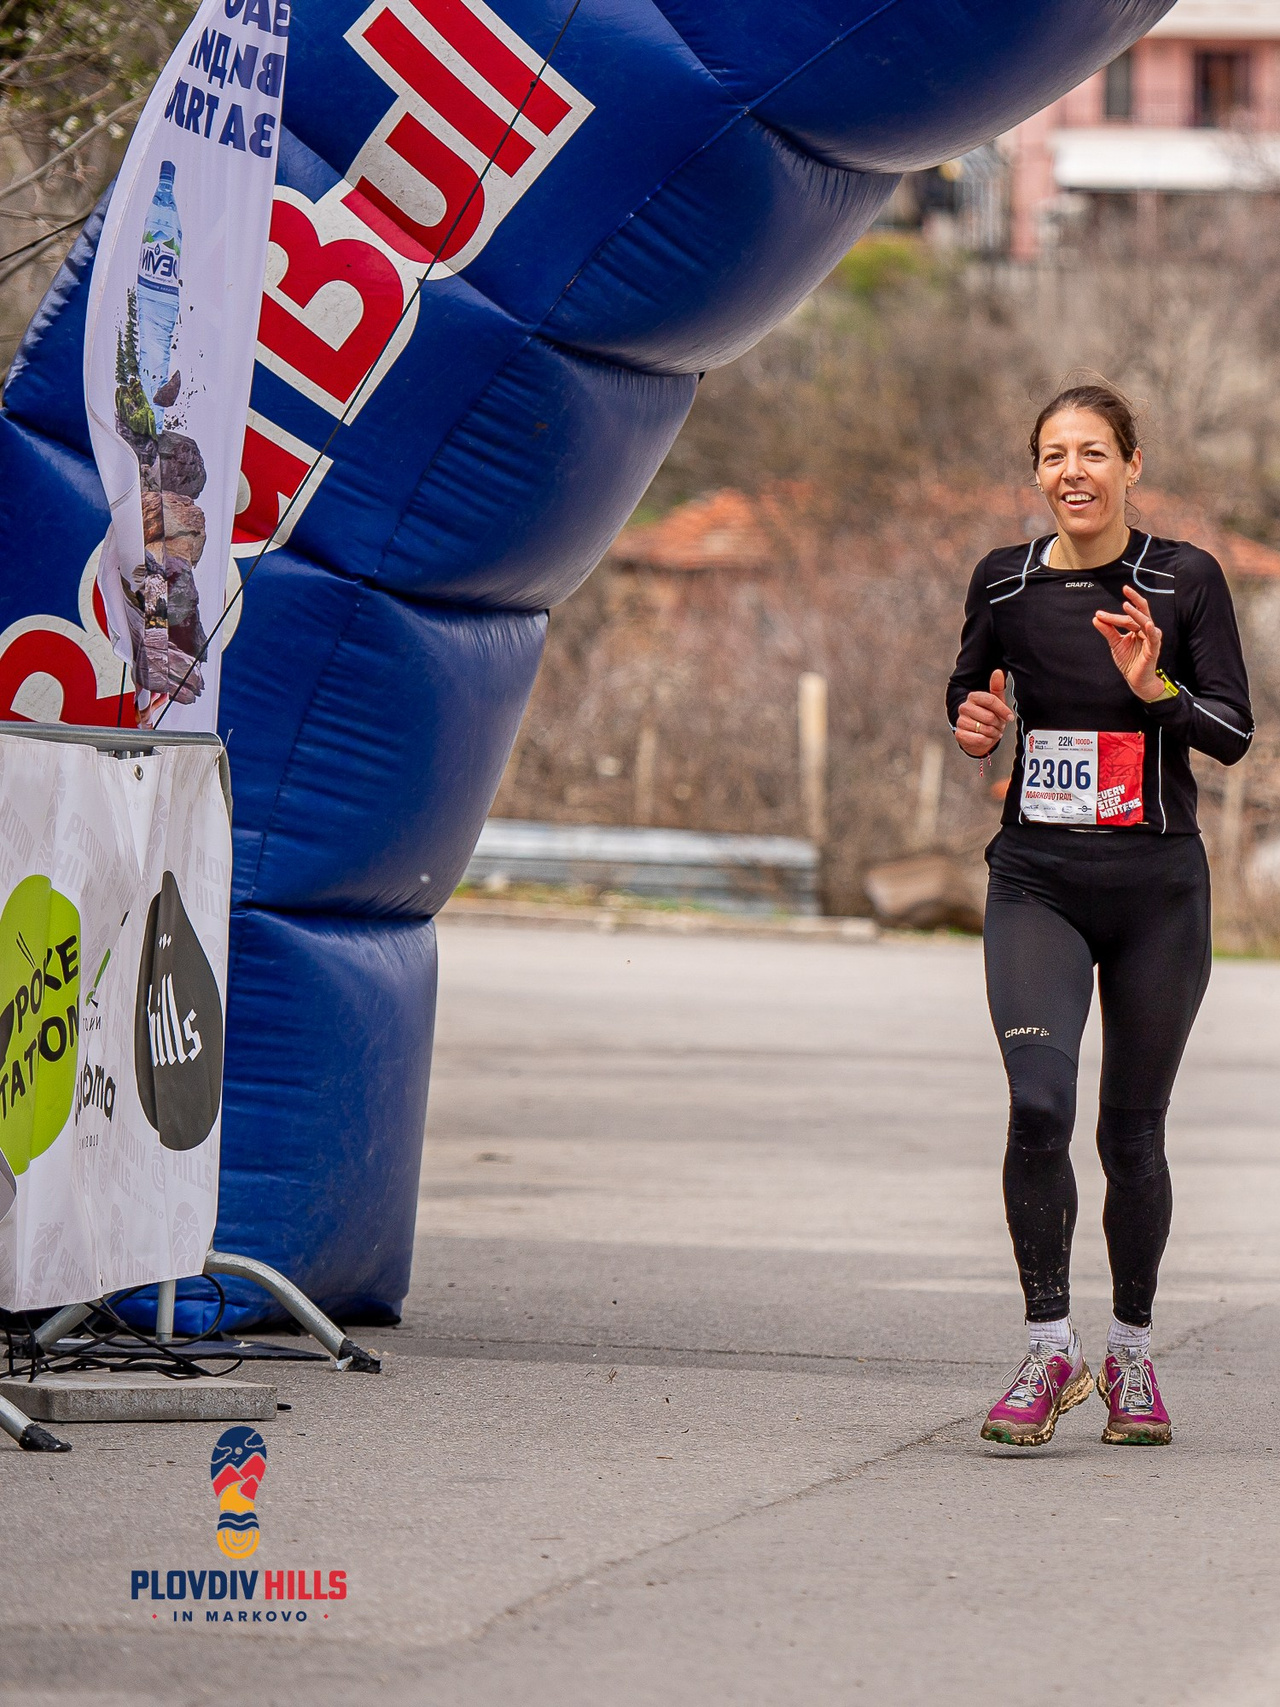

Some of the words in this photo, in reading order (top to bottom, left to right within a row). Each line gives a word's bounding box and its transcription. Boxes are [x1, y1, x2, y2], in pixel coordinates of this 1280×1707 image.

[1058, 736, 1073, 746] 22K
[1026, 758, 1091, 789] 2306
[1097, 796, 1121, 810] STEP
[1099, 798, 1142, 819] MATTERS
[15, 934, 79, 1033] POKE
[147, 973, 203, 1067] hills
[1004, 1027, 1040, 1039] CRAFT
